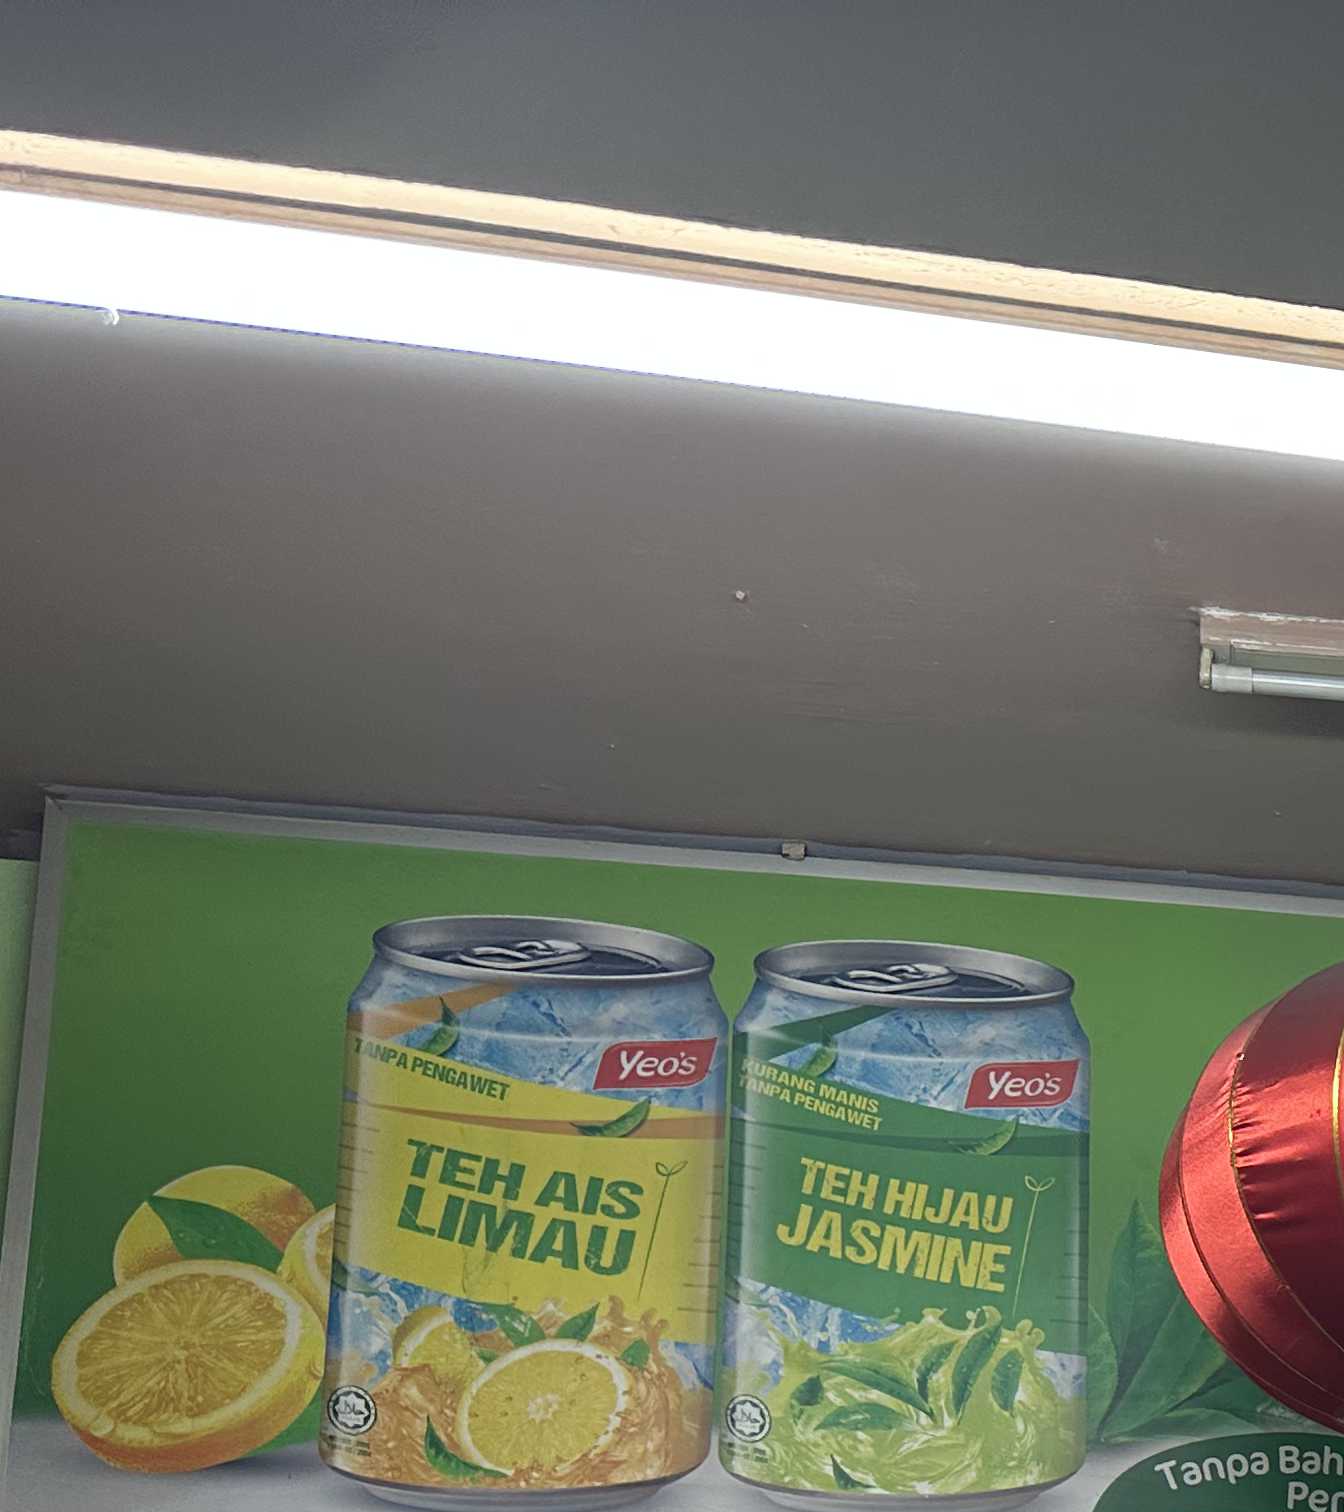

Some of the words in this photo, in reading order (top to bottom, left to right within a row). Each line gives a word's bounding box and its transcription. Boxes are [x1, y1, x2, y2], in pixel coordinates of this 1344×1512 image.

[354, 1037, 407, 1069] TANPA
[411, 1056, 511, 1101] PENGAWET
[617, 1049, 697, 1081] Yeo's
[742, 1057, 817, 1095] KURANG
[818, 1081, 880, 1113] MANIS
[987, 1070, 1062, 1100] Yeo's
[739, 1073, 791, 1104] TANPA
[793, 1092, 883, 1132] PENGAWET
[407, 1138, 526, 1201] TEH
[534, 1170, 645, 1220] AIS
[800, 1157, 880, 1211] TEH
[882, 1178, 1014, 1234] HIJAU
[396, 1184, 637, 1277] LIMAU
[775, 1203, 1012, 1293] JASMINE
[1154, 1450, 1270, 1490] Tanpa
